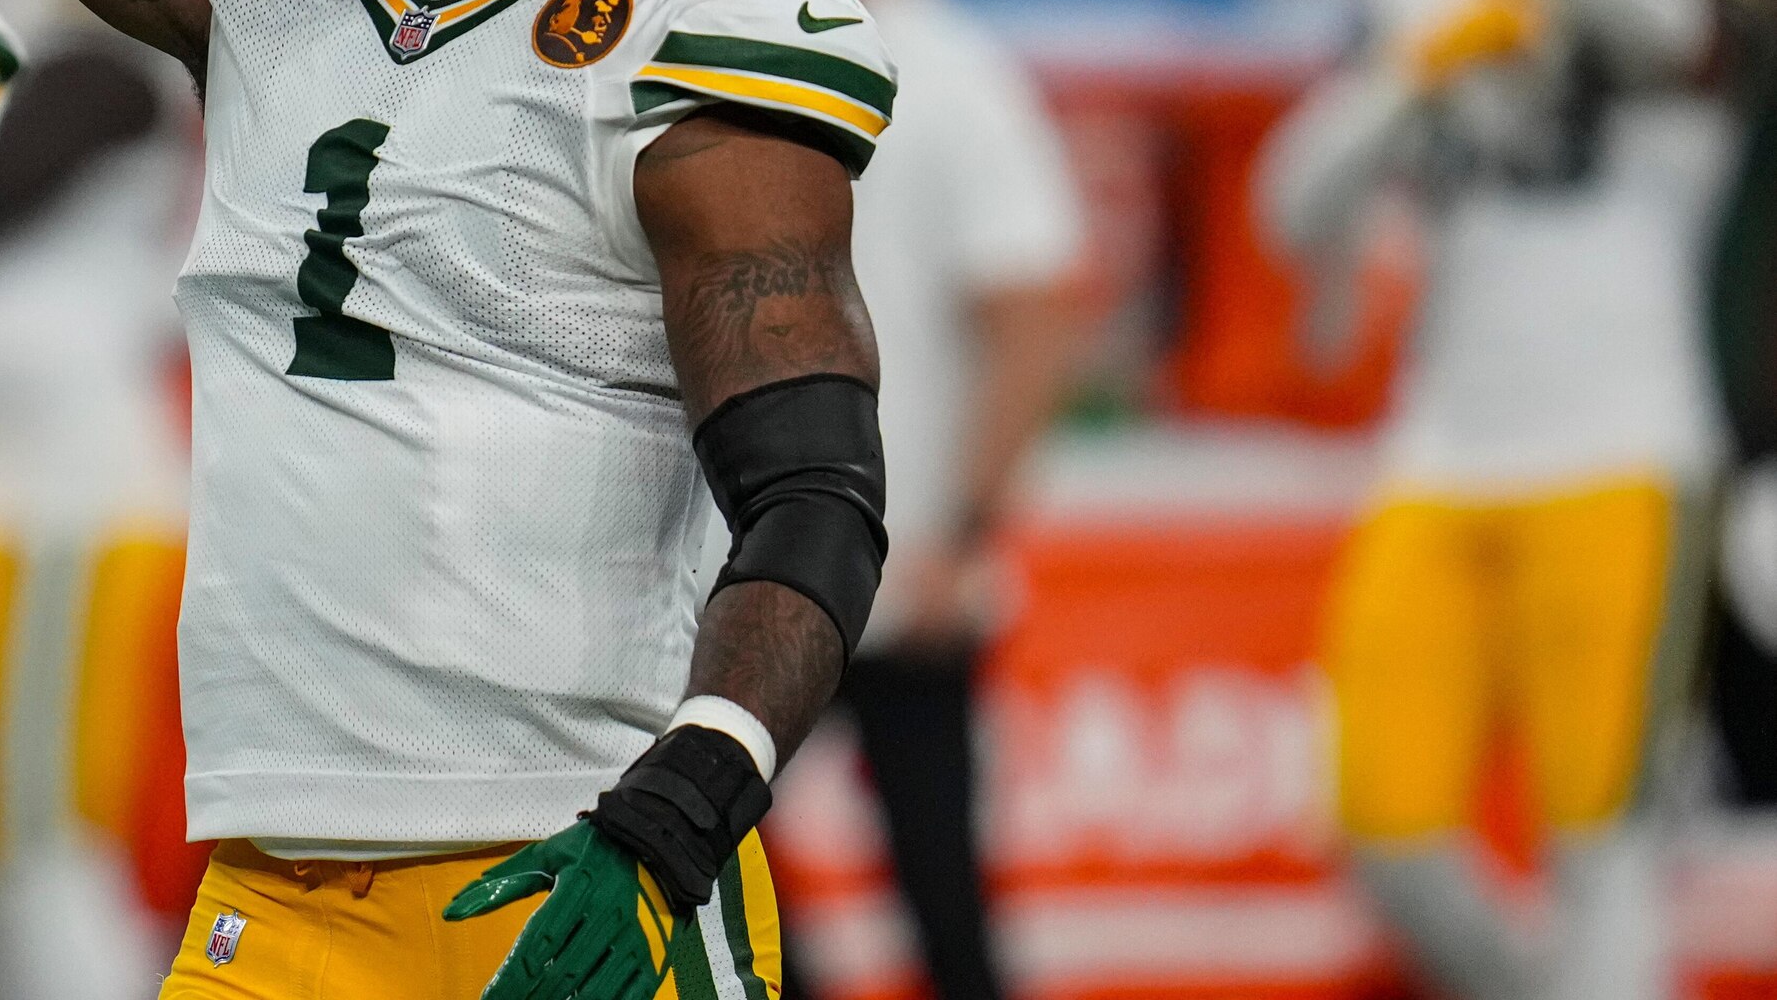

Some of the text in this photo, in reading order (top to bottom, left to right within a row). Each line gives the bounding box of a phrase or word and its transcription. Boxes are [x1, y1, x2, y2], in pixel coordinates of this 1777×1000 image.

[396, 27, 422, 48] NFL
[285, 118, 396, 380] 1
[209, 933, 231, 957] NFL
